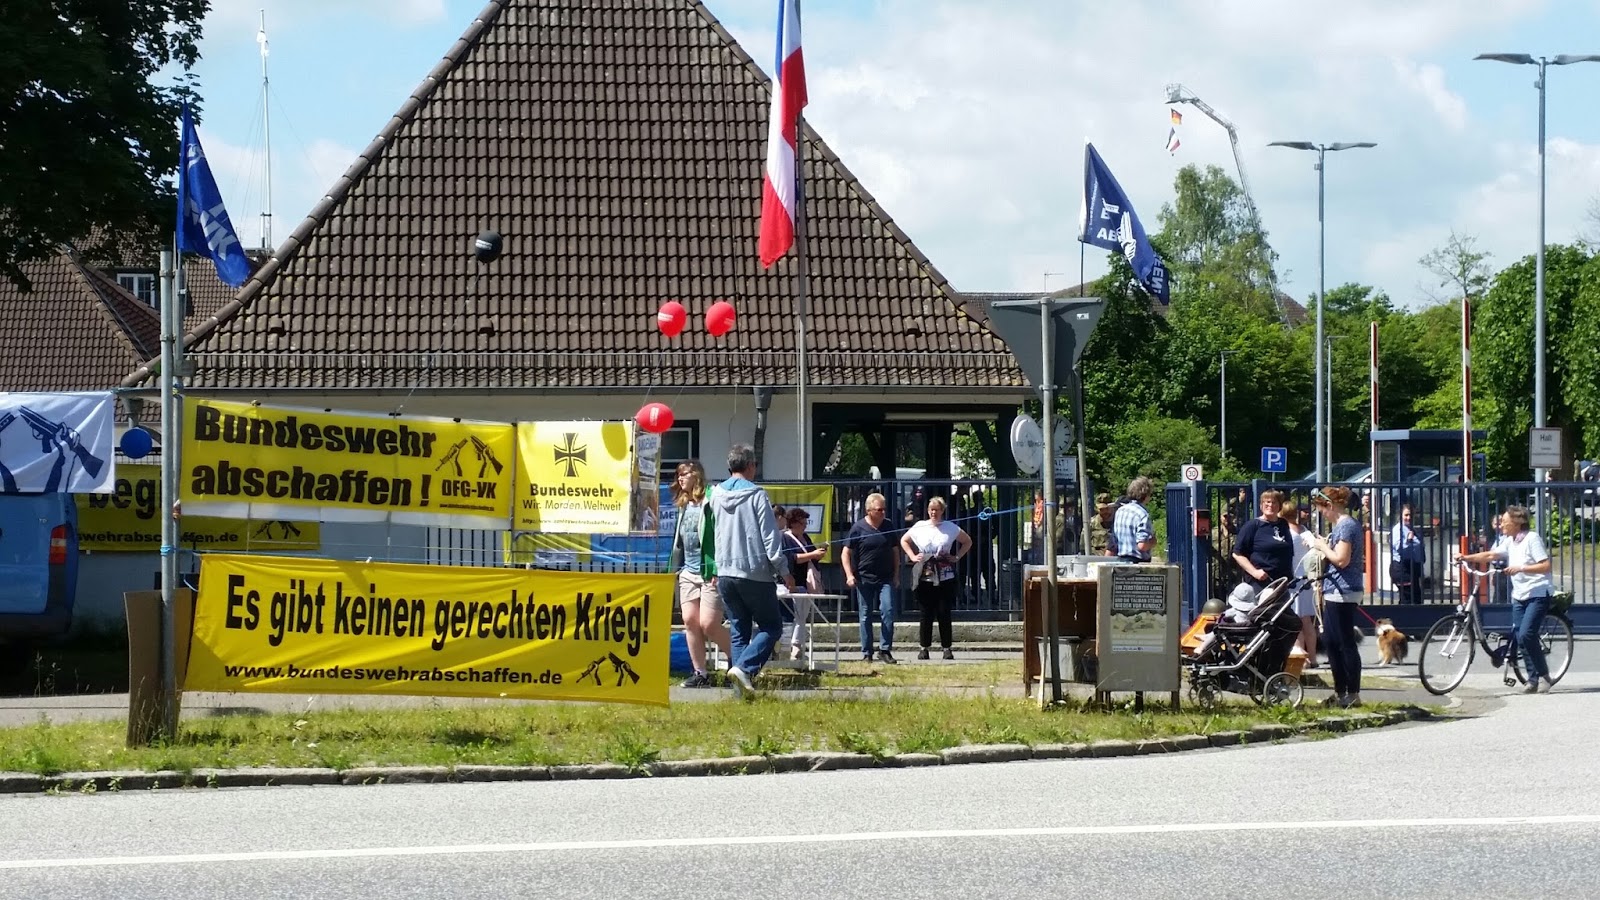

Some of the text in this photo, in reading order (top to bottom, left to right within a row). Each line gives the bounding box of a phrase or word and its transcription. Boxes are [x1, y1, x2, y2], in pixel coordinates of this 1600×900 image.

[194, 405, 437, 458] Bundeswehr
[1267, 451, 1281, 469] P
[442, 479, 497, 499] DFG-VK
[530, 483, 614, 498] Bundeswehr
[523, 500, 542, 510] Wir.
[226, 574, 650, 657] Es gibt keinen gerechten Krieg!
[224, 663, 563, 686] www.bundeswehrabschaffen.de
